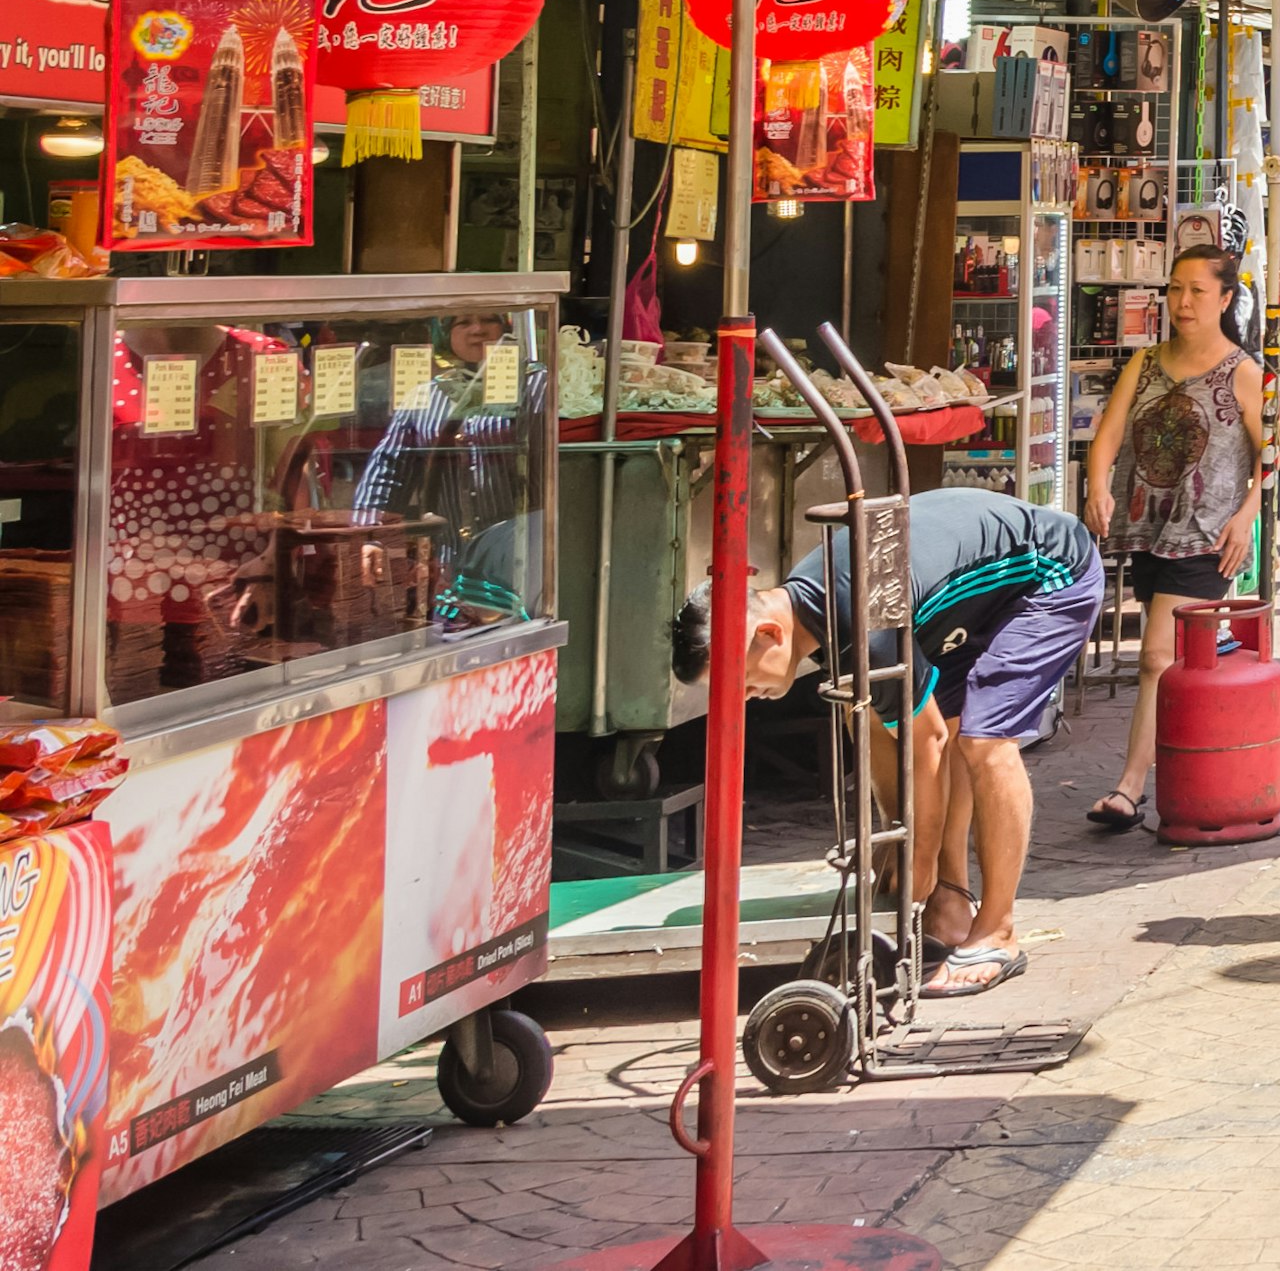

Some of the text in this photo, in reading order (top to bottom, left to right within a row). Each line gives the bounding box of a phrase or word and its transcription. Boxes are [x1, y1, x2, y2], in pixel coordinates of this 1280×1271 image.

[16, 38, 33, 69] it,
[39, 44, 85, 72] you'll
[89, 46, 106, 71] lo
[408, 930, 534, 1005] A1 Dried Pork (Slice)
[108, 1130, 128, 1160] A5
[195, 1089, 227, 1116] Heong
[229, 1076, 244, 1099] Fei
[245, 1066, 267, 1090] Meat
